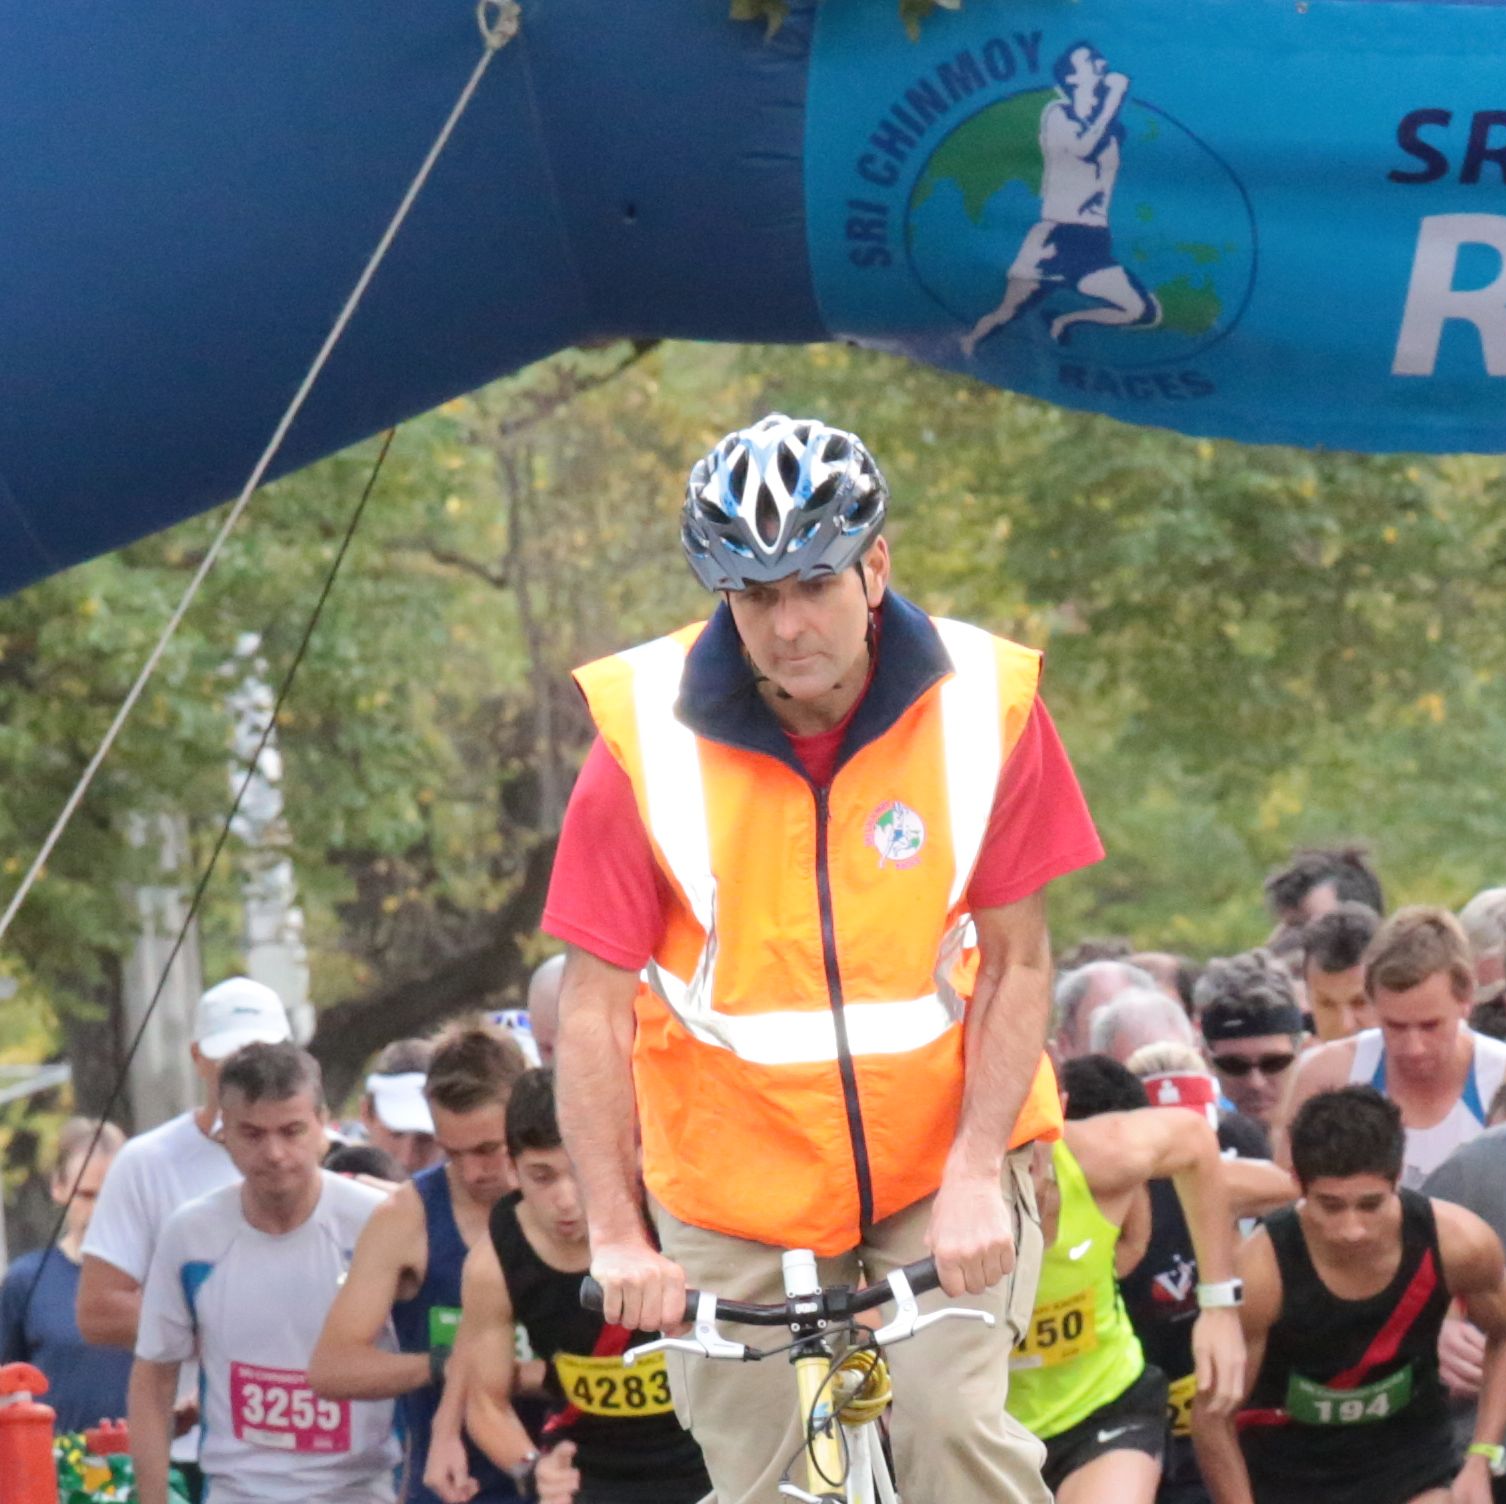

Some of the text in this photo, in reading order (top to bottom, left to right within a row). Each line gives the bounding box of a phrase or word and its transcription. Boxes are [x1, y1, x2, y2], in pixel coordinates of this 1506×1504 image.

[844, 29, 1044, 269] SRI CHINMOY
[1058, 363, 1216, 400] RACES
[241, 1382, 341, 1432] 3255
[572, 1368, 672, 1409] 4283
[1313, 1391, 1390, 1424] 194
